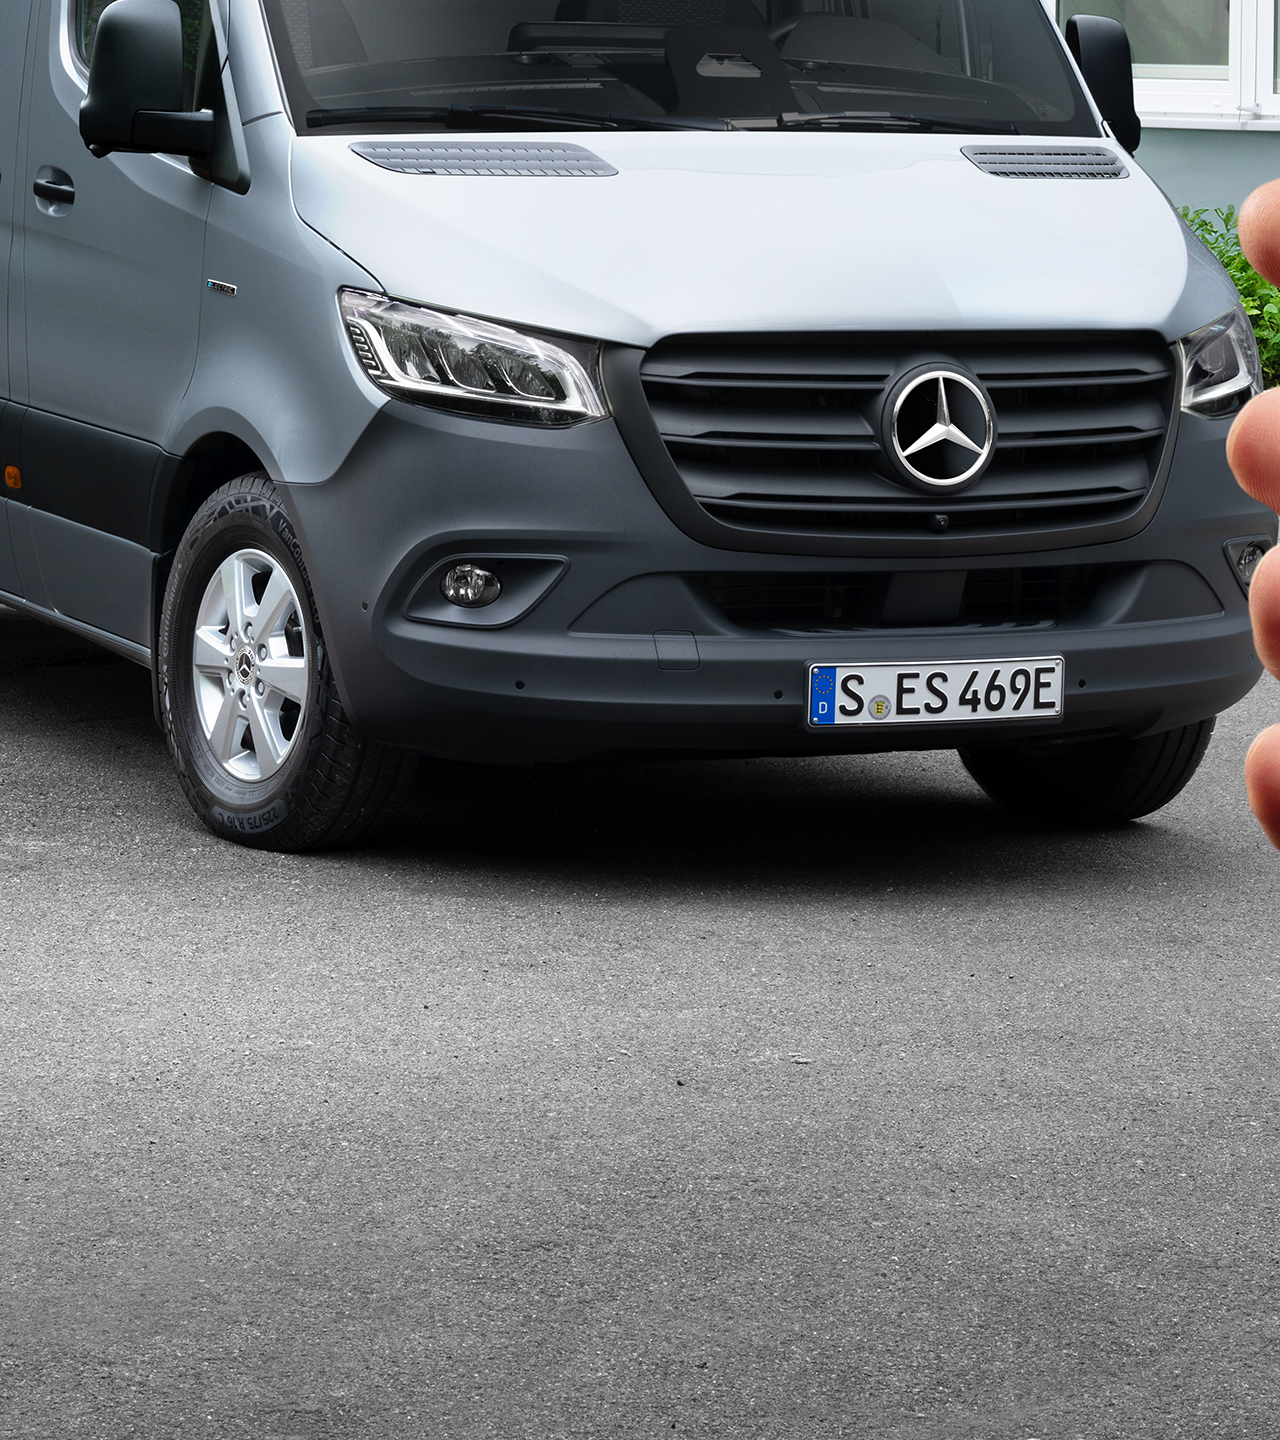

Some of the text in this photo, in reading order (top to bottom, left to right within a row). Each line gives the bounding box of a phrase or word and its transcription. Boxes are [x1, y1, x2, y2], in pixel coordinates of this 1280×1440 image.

[838, 666, 1056, 717] S ES 469E
[818, 701, 828, 714] D
[227, 815, 237, 830] 16
[237, 817, 246, 831] R
[247, 806, 280, 831] 225/75
